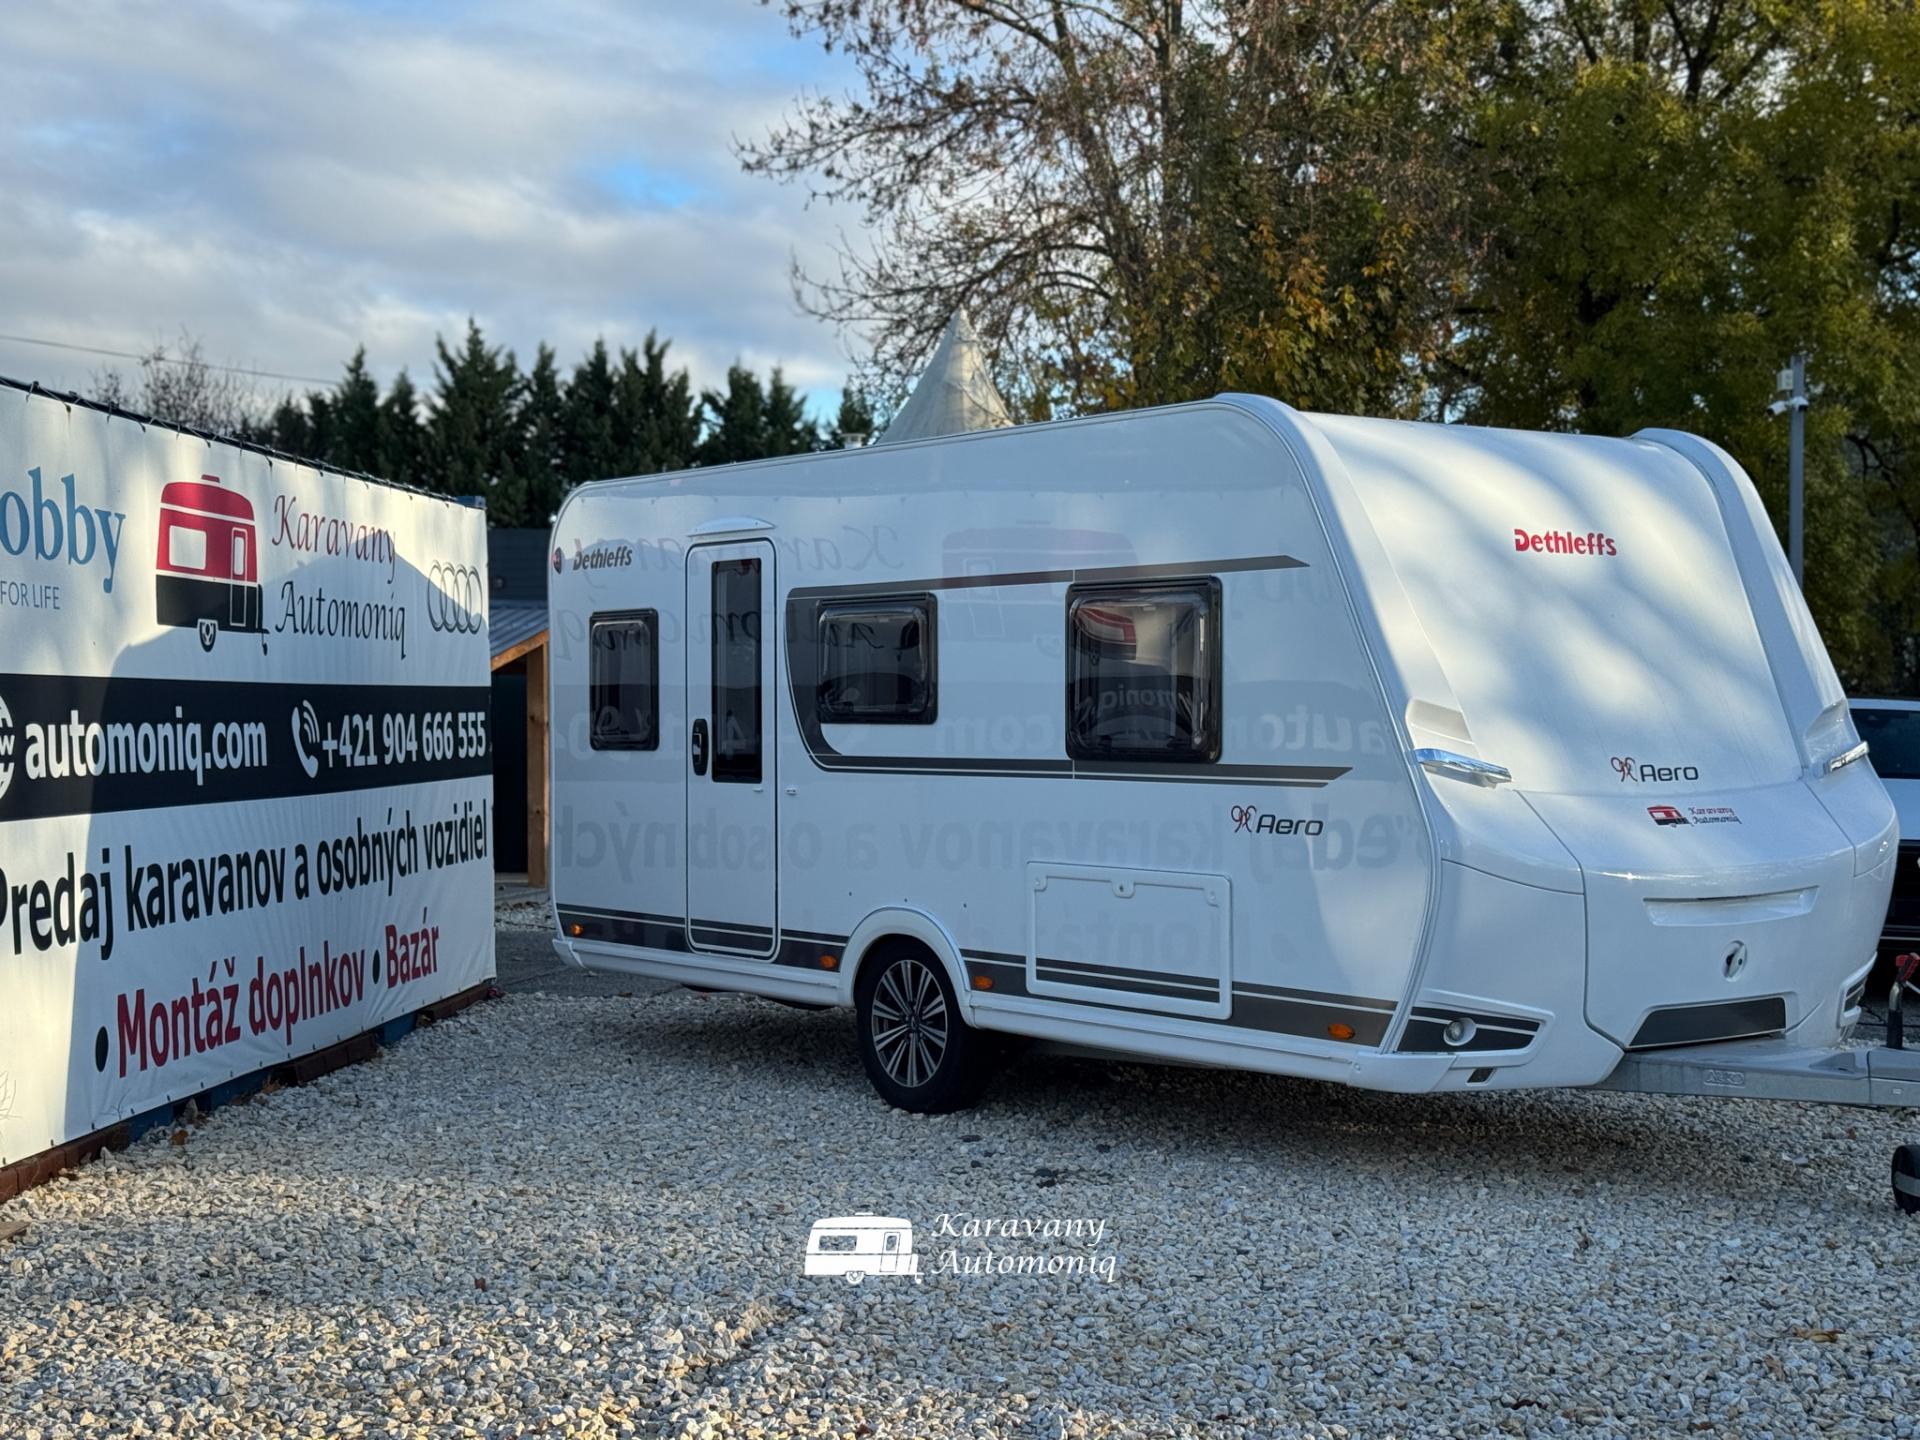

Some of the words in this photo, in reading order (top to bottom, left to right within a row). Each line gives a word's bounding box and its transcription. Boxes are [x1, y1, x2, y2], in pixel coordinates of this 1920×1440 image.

[272, 495, 396, 584] Karavany
[572, 545, 633, 571] Dethleffs
[1514, 528, 1617, 556] Dethleffs
[0, 580, 29, 607] FOR
[32, 583, 61, 610] LIFE
[275, 581, 407, 660] Automoniq
[25, 706, 268, 786] automoniq.com
[322, 714, 378, 768] +421
[382, 712, 418, 765] 904
[422, 711, 454, 761] 666
[458, 711, 486, 759] 555
[1640, 764, 1699, 782] Aero
[1256, 814, 1324, 836] Aero
[125, 845, 286, 932] karavanov
[294, 844, 309, 900] a
[316, 807, 418, 897] osobných
[423, 798, 487, 870] vozidiel
[117, 956, 241, 1078] Montáž
[249, 940, 365, 1046] doplnkov
[385, 907, 439, 989] Bazár
